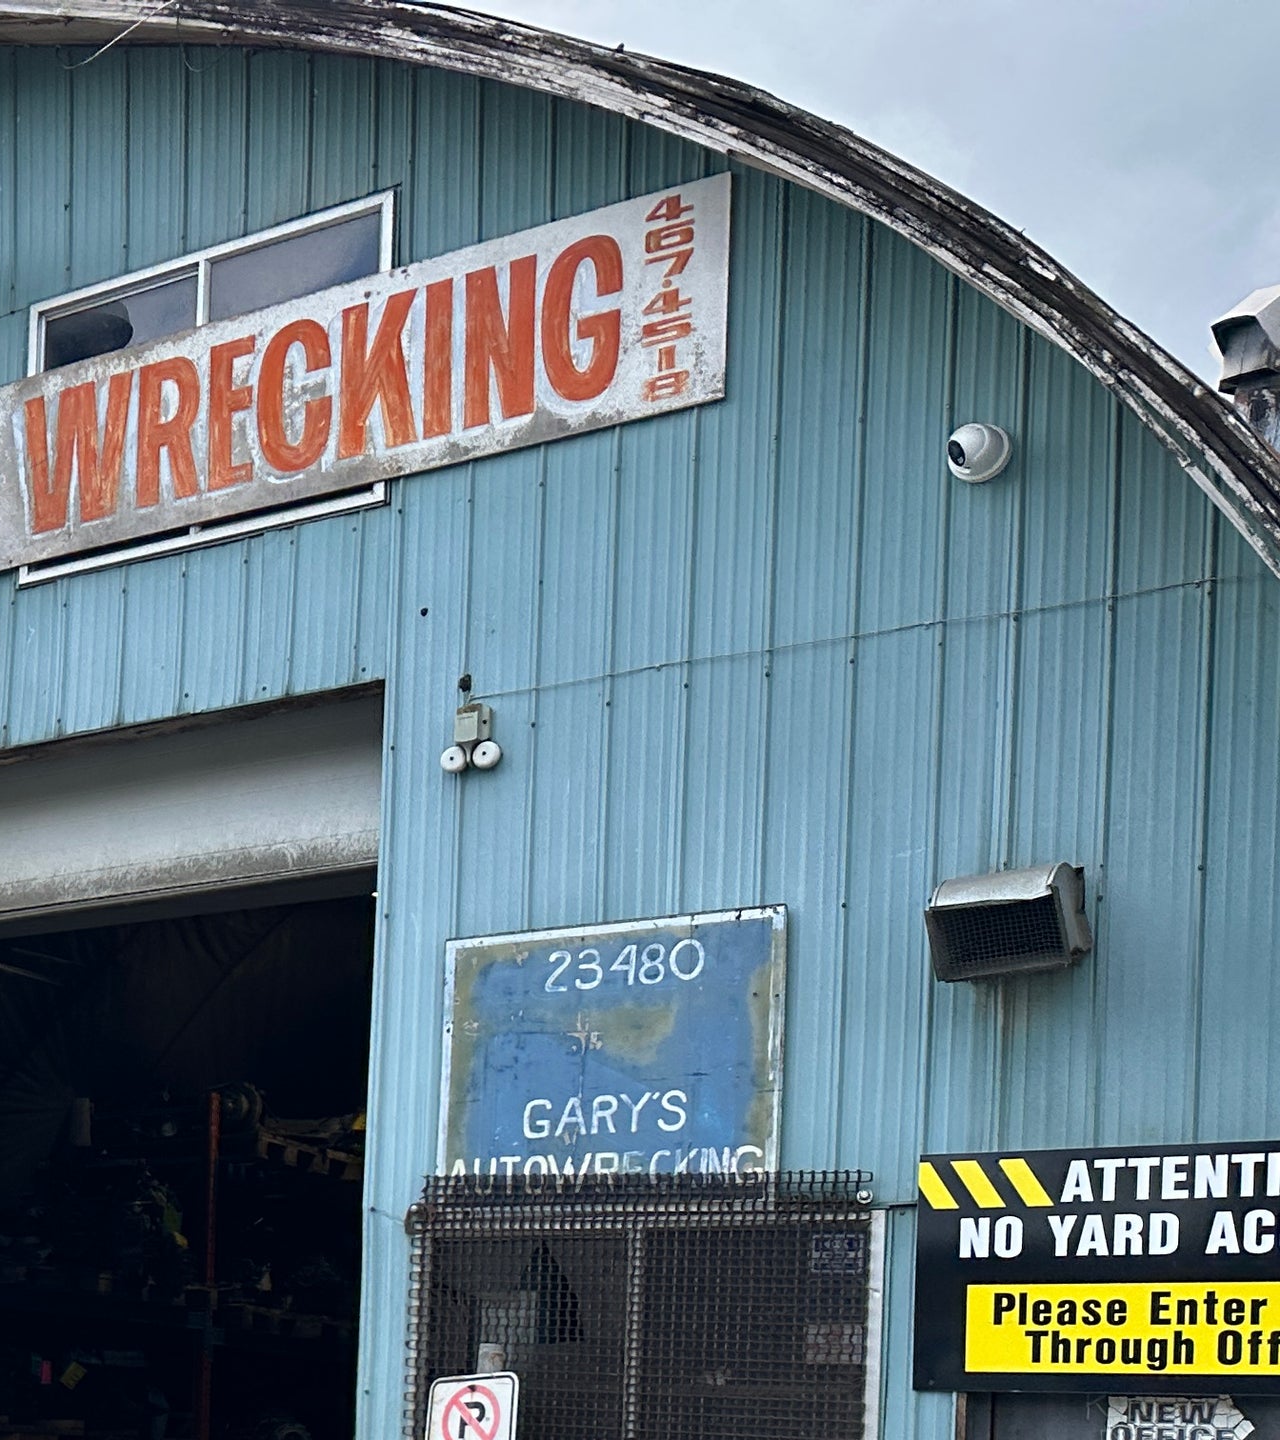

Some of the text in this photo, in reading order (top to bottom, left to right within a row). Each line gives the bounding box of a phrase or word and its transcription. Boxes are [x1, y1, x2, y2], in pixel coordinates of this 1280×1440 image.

[23, 234, 624, 535] WRECKING
[544, 938, 705, 993] 23480
[523, 1089, 688, 1140] GARY'S
[1060, 1152, 1280, 1203] ATTENTI
[959, 1209, 1276, 1259] NO YARD AC
[993, 1290, 1268, 1326] Please Enter
[1025, 1329, 1280, 1371] Through Off
[1128, 1400, 1216, 1424] NEW
